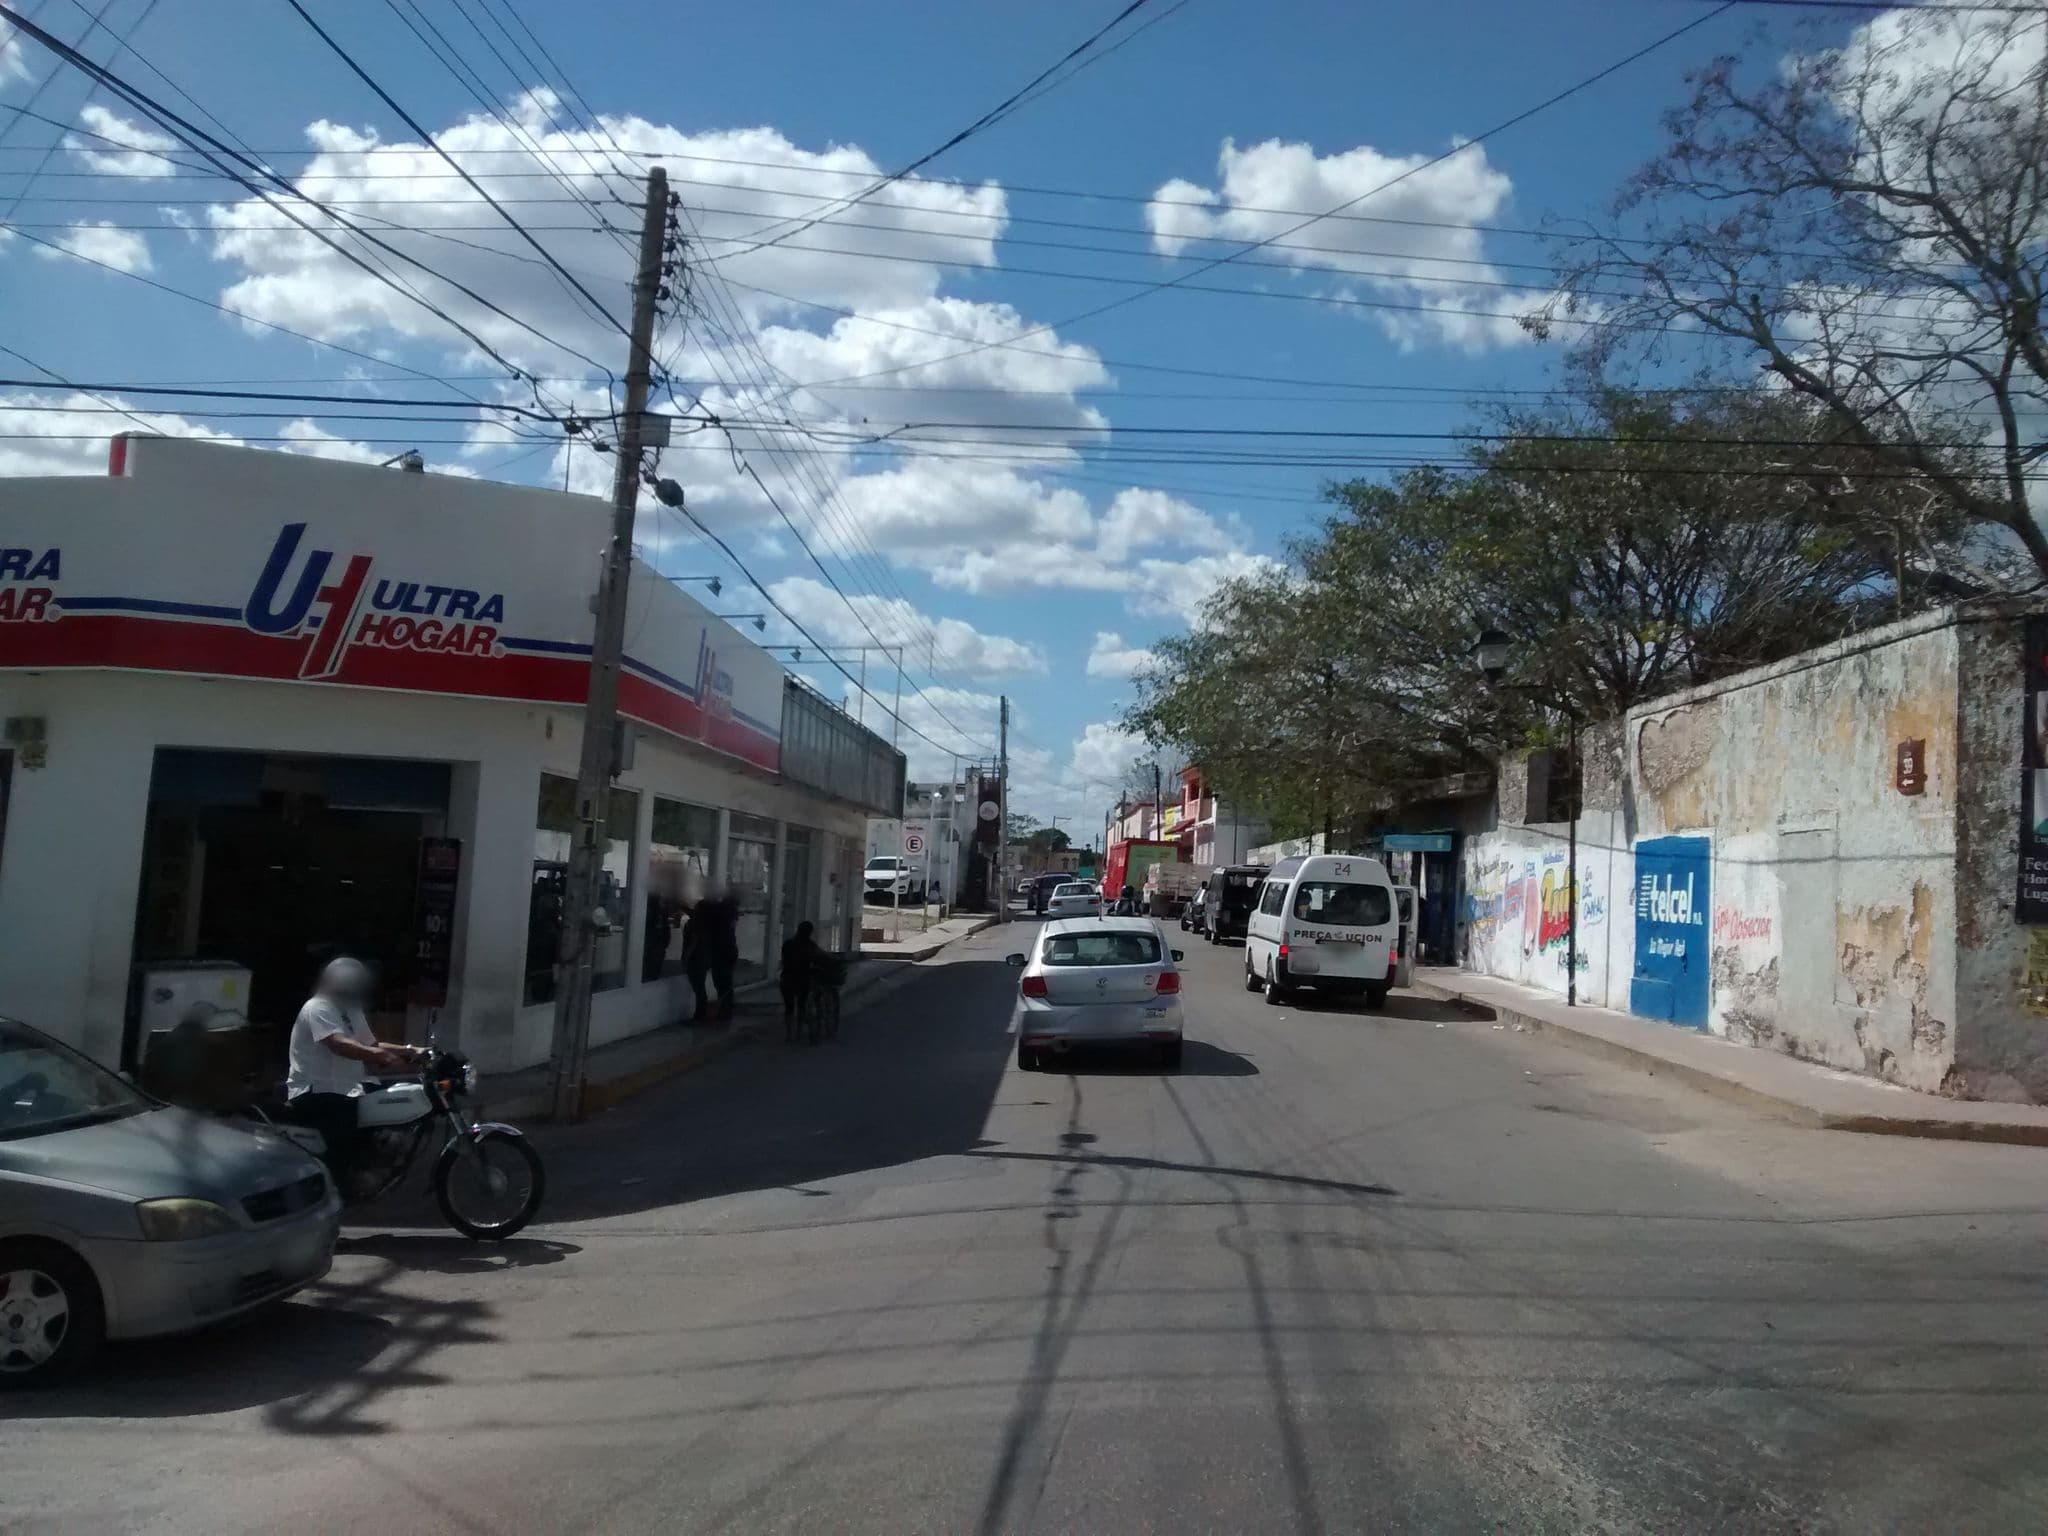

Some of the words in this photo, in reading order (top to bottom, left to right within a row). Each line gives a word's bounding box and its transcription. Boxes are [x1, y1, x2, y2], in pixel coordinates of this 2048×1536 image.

[0, 549, 61, 580] RA
[371, 579, 504, 623] ULTRA
[354, 613, 498, 655] HOGAR
[910, 839, 919, 850] E
[1334, 862, 1351, 876] 24
[1650, 872, 1694, 924] telcel
